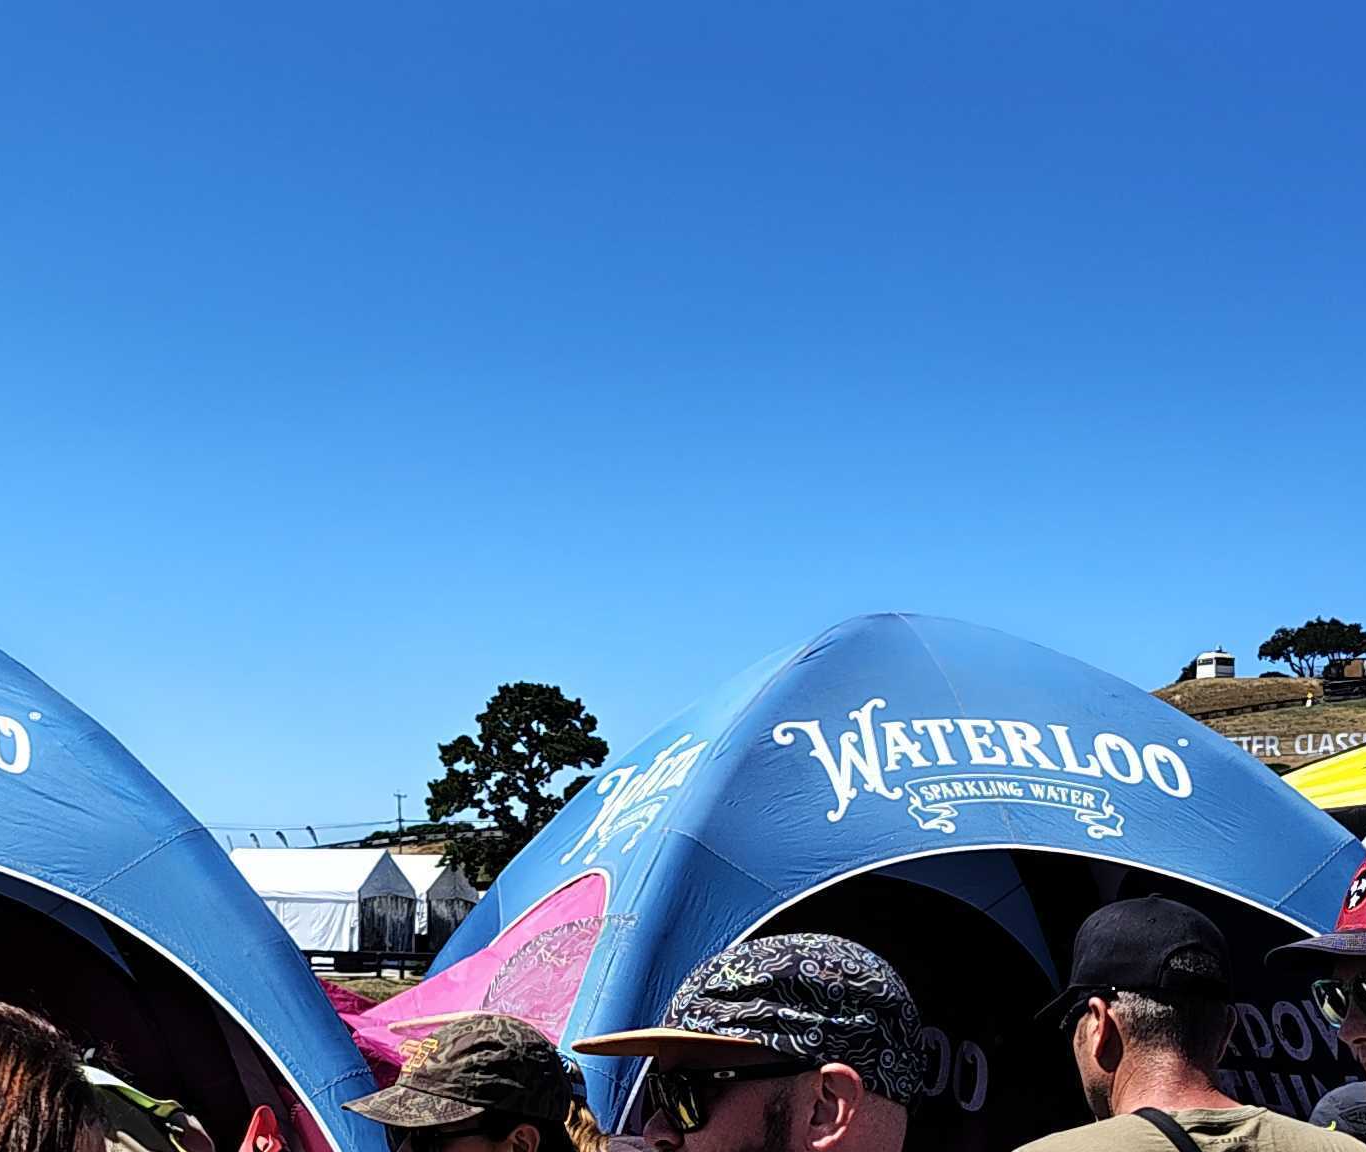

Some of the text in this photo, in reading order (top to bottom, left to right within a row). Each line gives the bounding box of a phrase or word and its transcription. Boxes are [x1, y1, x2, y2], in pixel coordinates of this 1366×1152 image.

[772, 698, 1195, 823] WATERLOO
[919, 779, 1096, 809] SPARKLING WATER
